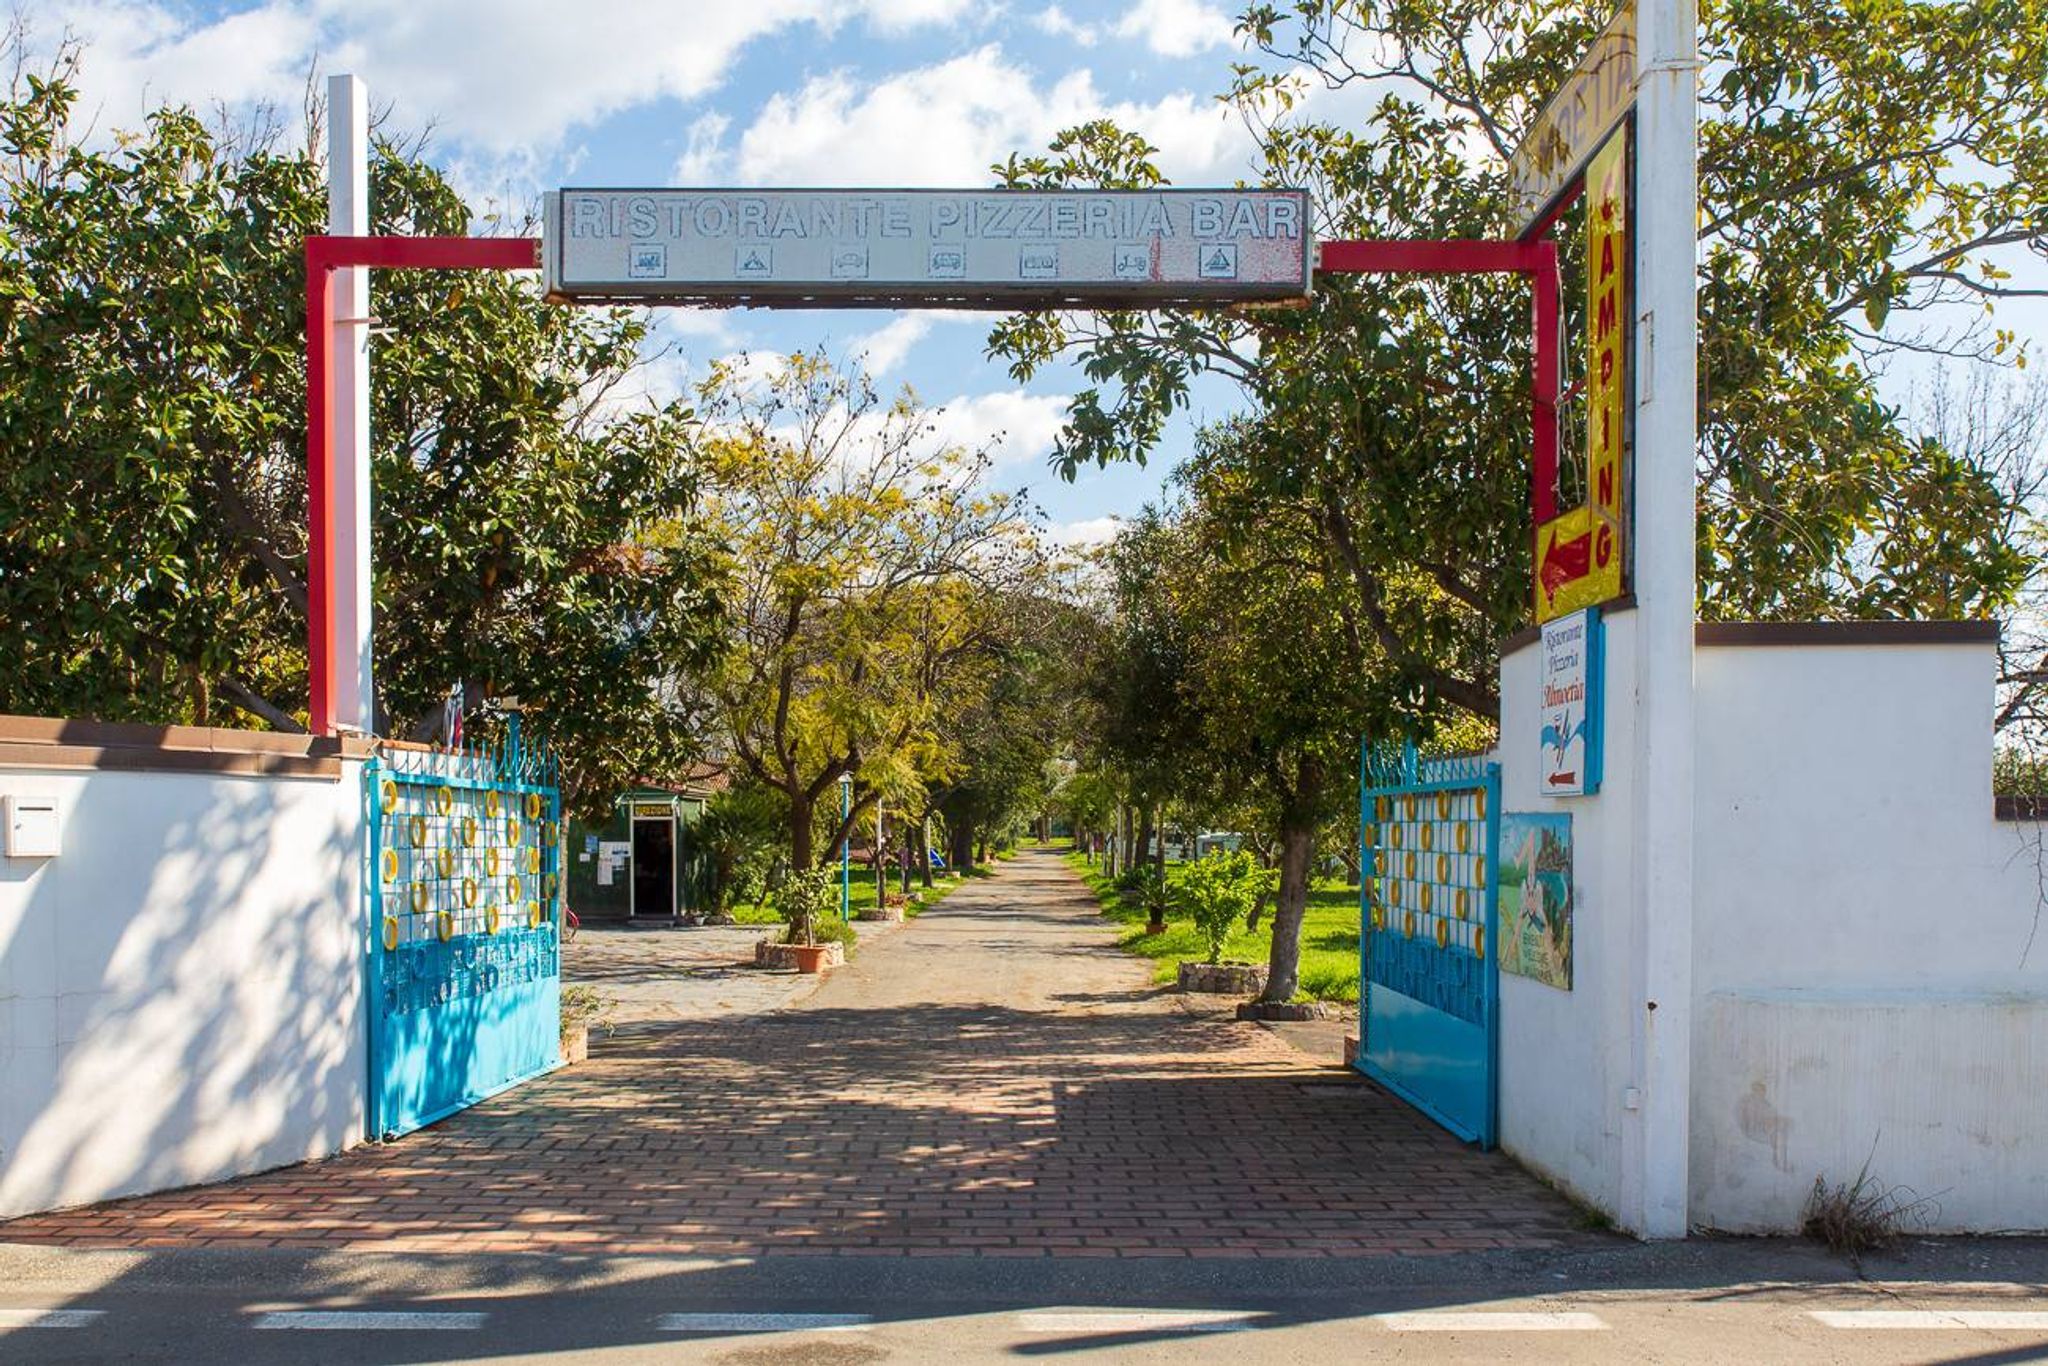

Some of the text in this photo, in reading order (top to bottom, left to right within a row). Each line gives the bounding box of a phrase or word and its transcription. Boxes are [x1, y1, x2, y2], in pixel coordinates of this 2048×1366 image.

[571, 196, 1300, 239] RISTORANTE PIZZERIA BAR
[1549, 649, 1579, 675] Pizzeria
